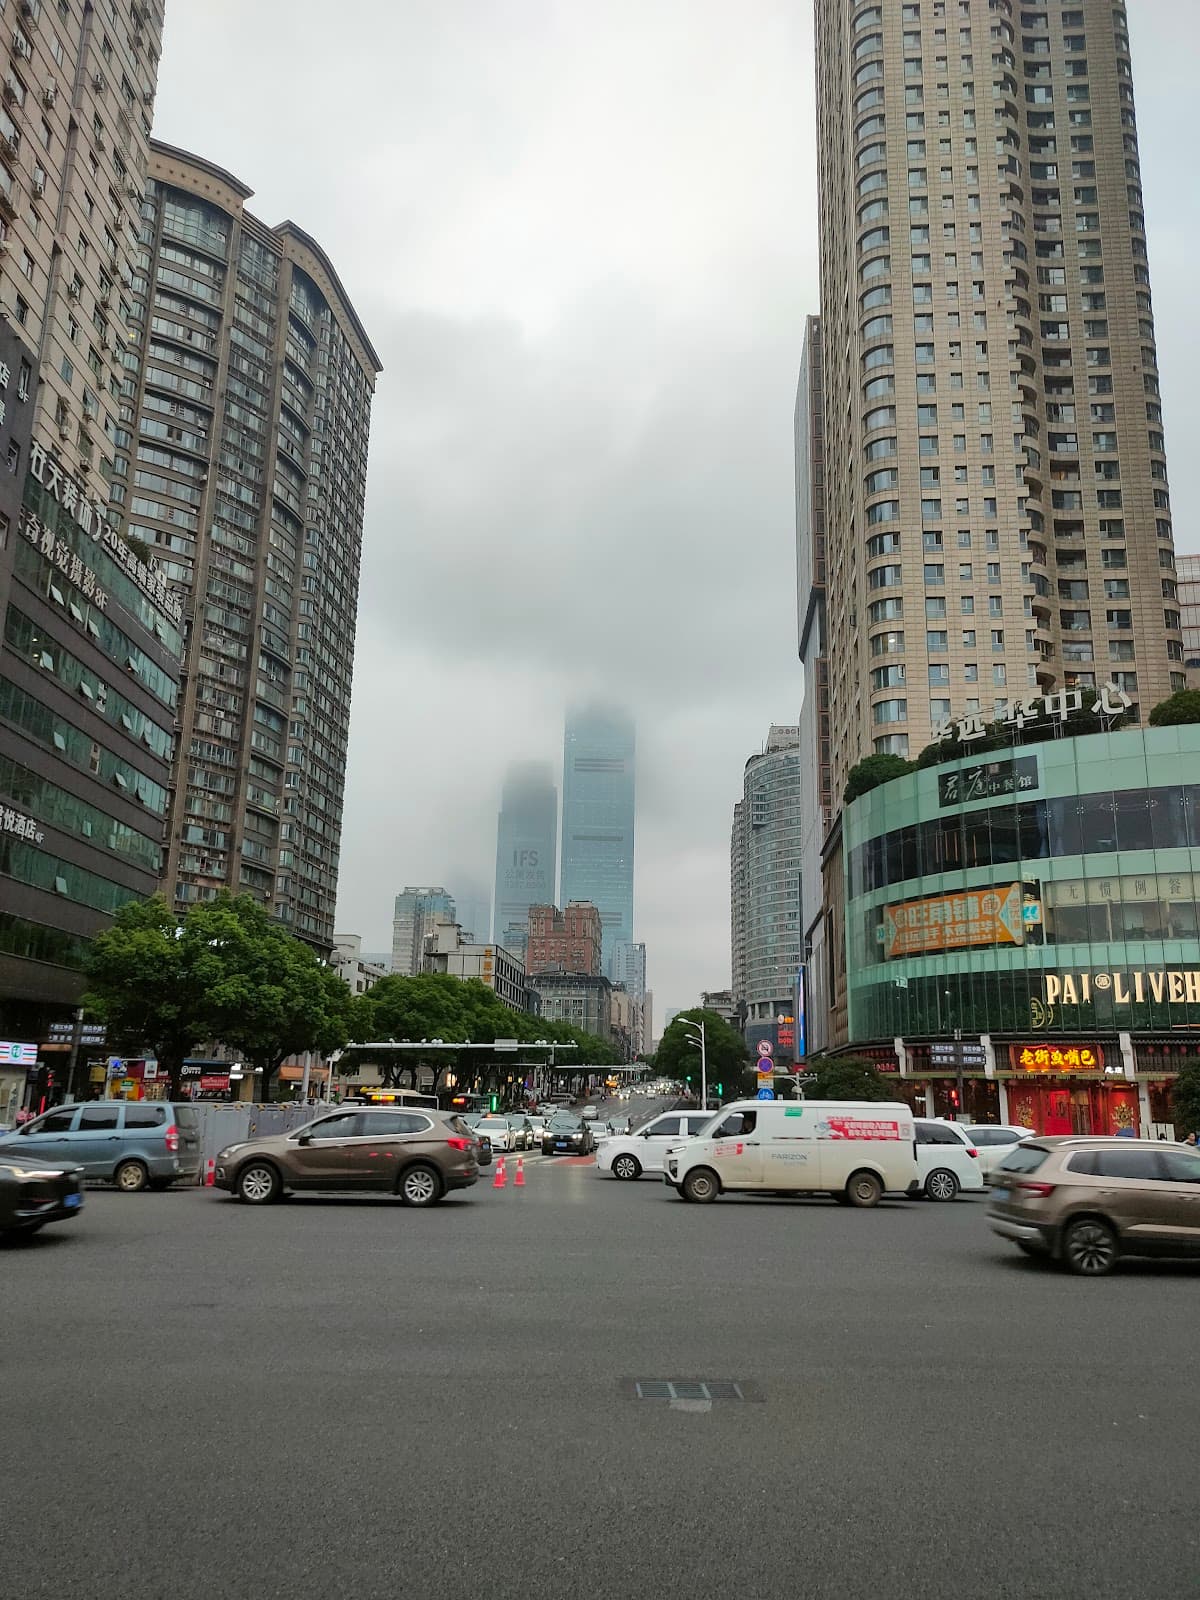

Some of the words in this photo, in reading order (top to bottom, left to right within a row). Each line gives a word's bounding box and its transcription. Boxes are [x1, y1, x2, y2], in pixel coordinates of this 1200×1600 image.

[18, 387, 29, 402] 9F
[95, 588, 108, 610] 8F
[513, 850, 538, 867] IFS
[1045, 974, 1091, 1005] PAI
